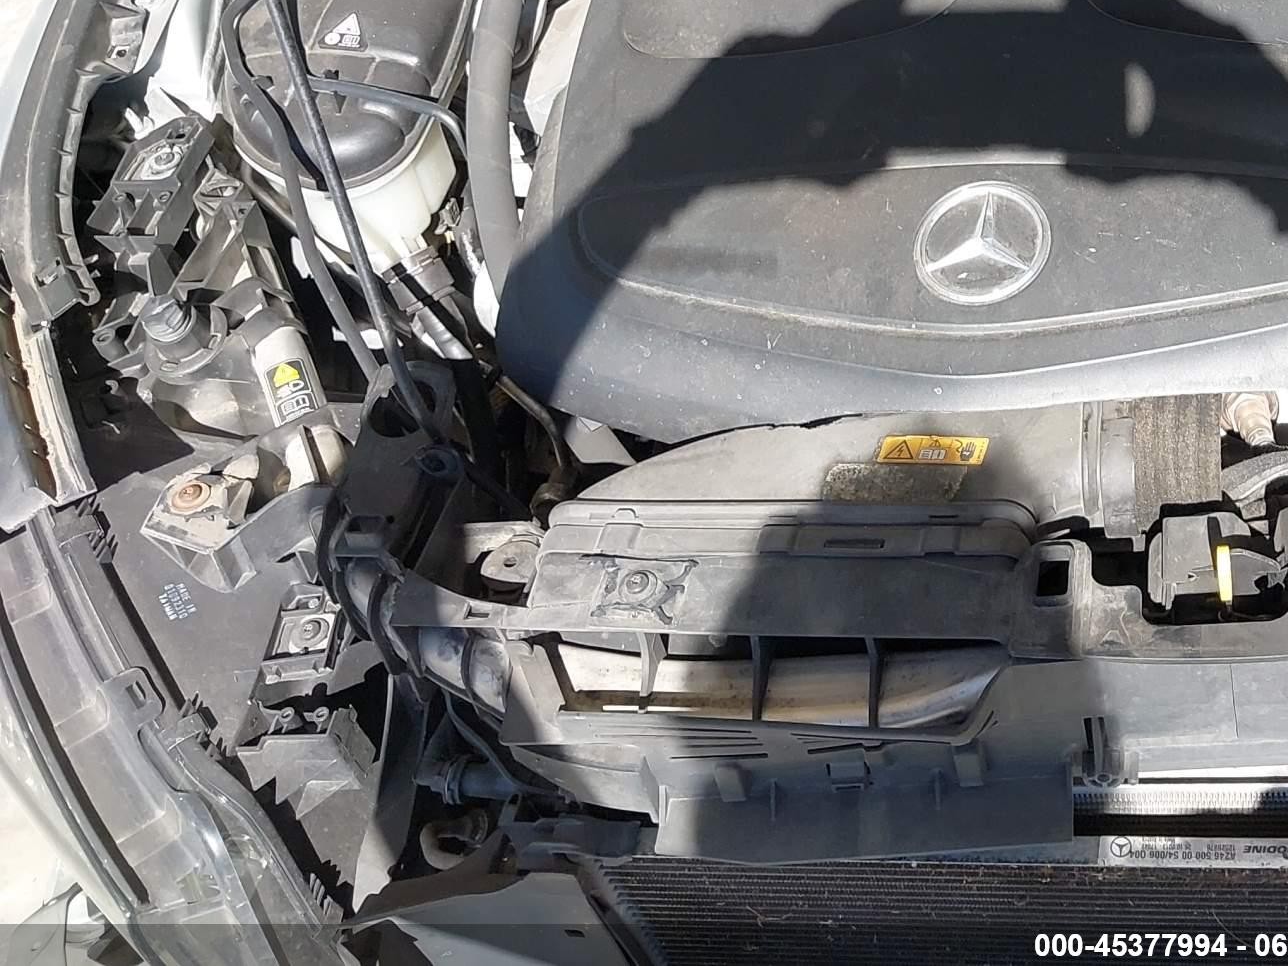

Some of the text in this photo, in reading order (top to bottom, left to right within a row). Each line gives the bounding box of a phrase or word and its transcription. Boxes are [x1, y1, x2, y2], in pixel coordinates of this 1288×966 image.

[175, 583, 192, 602] MADE
[158, 593, 178, 620] TAIWAN
[1182, 851, 1192, 860] 00
[1195, 851, 1211, 860] 500
